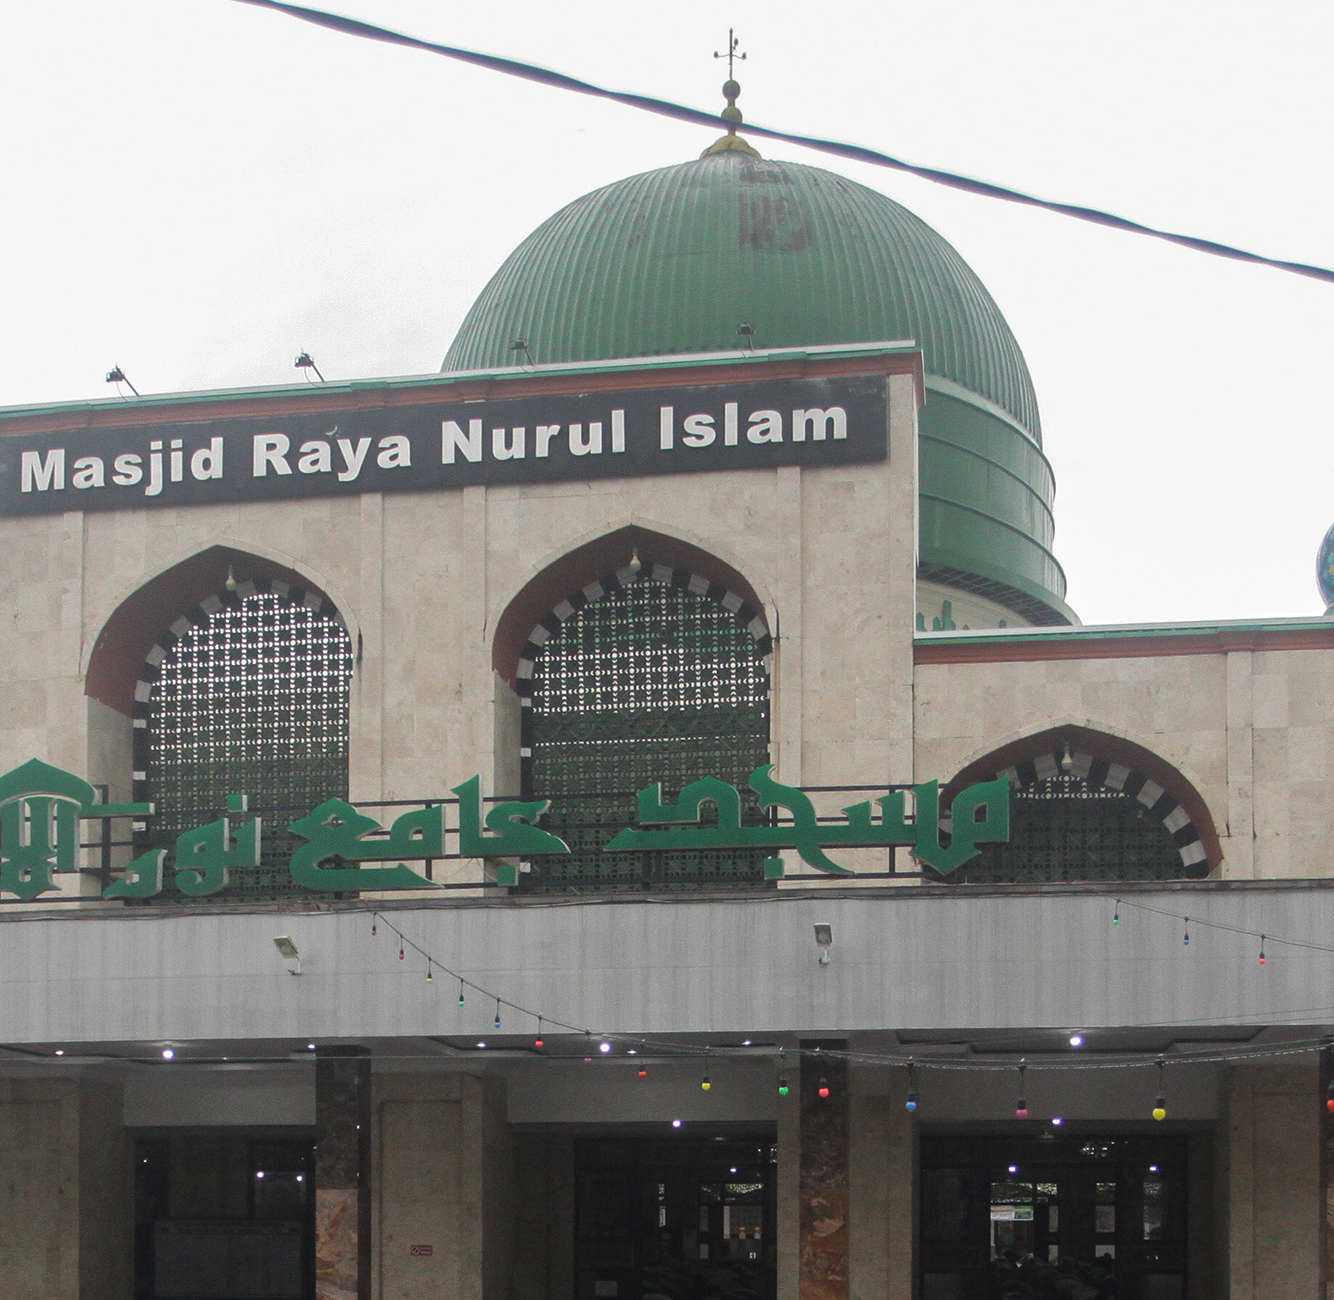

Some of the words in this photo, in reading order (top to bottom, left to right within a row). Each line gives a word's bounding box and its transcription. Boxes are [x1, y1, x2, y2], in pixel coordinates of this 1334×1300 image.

[21, 436, 223, 497] Masjid
[253, 433, 411, 482] Raya
[441, 408, 625, 465] Nurul
[660, 402, 847, 450] Islam
